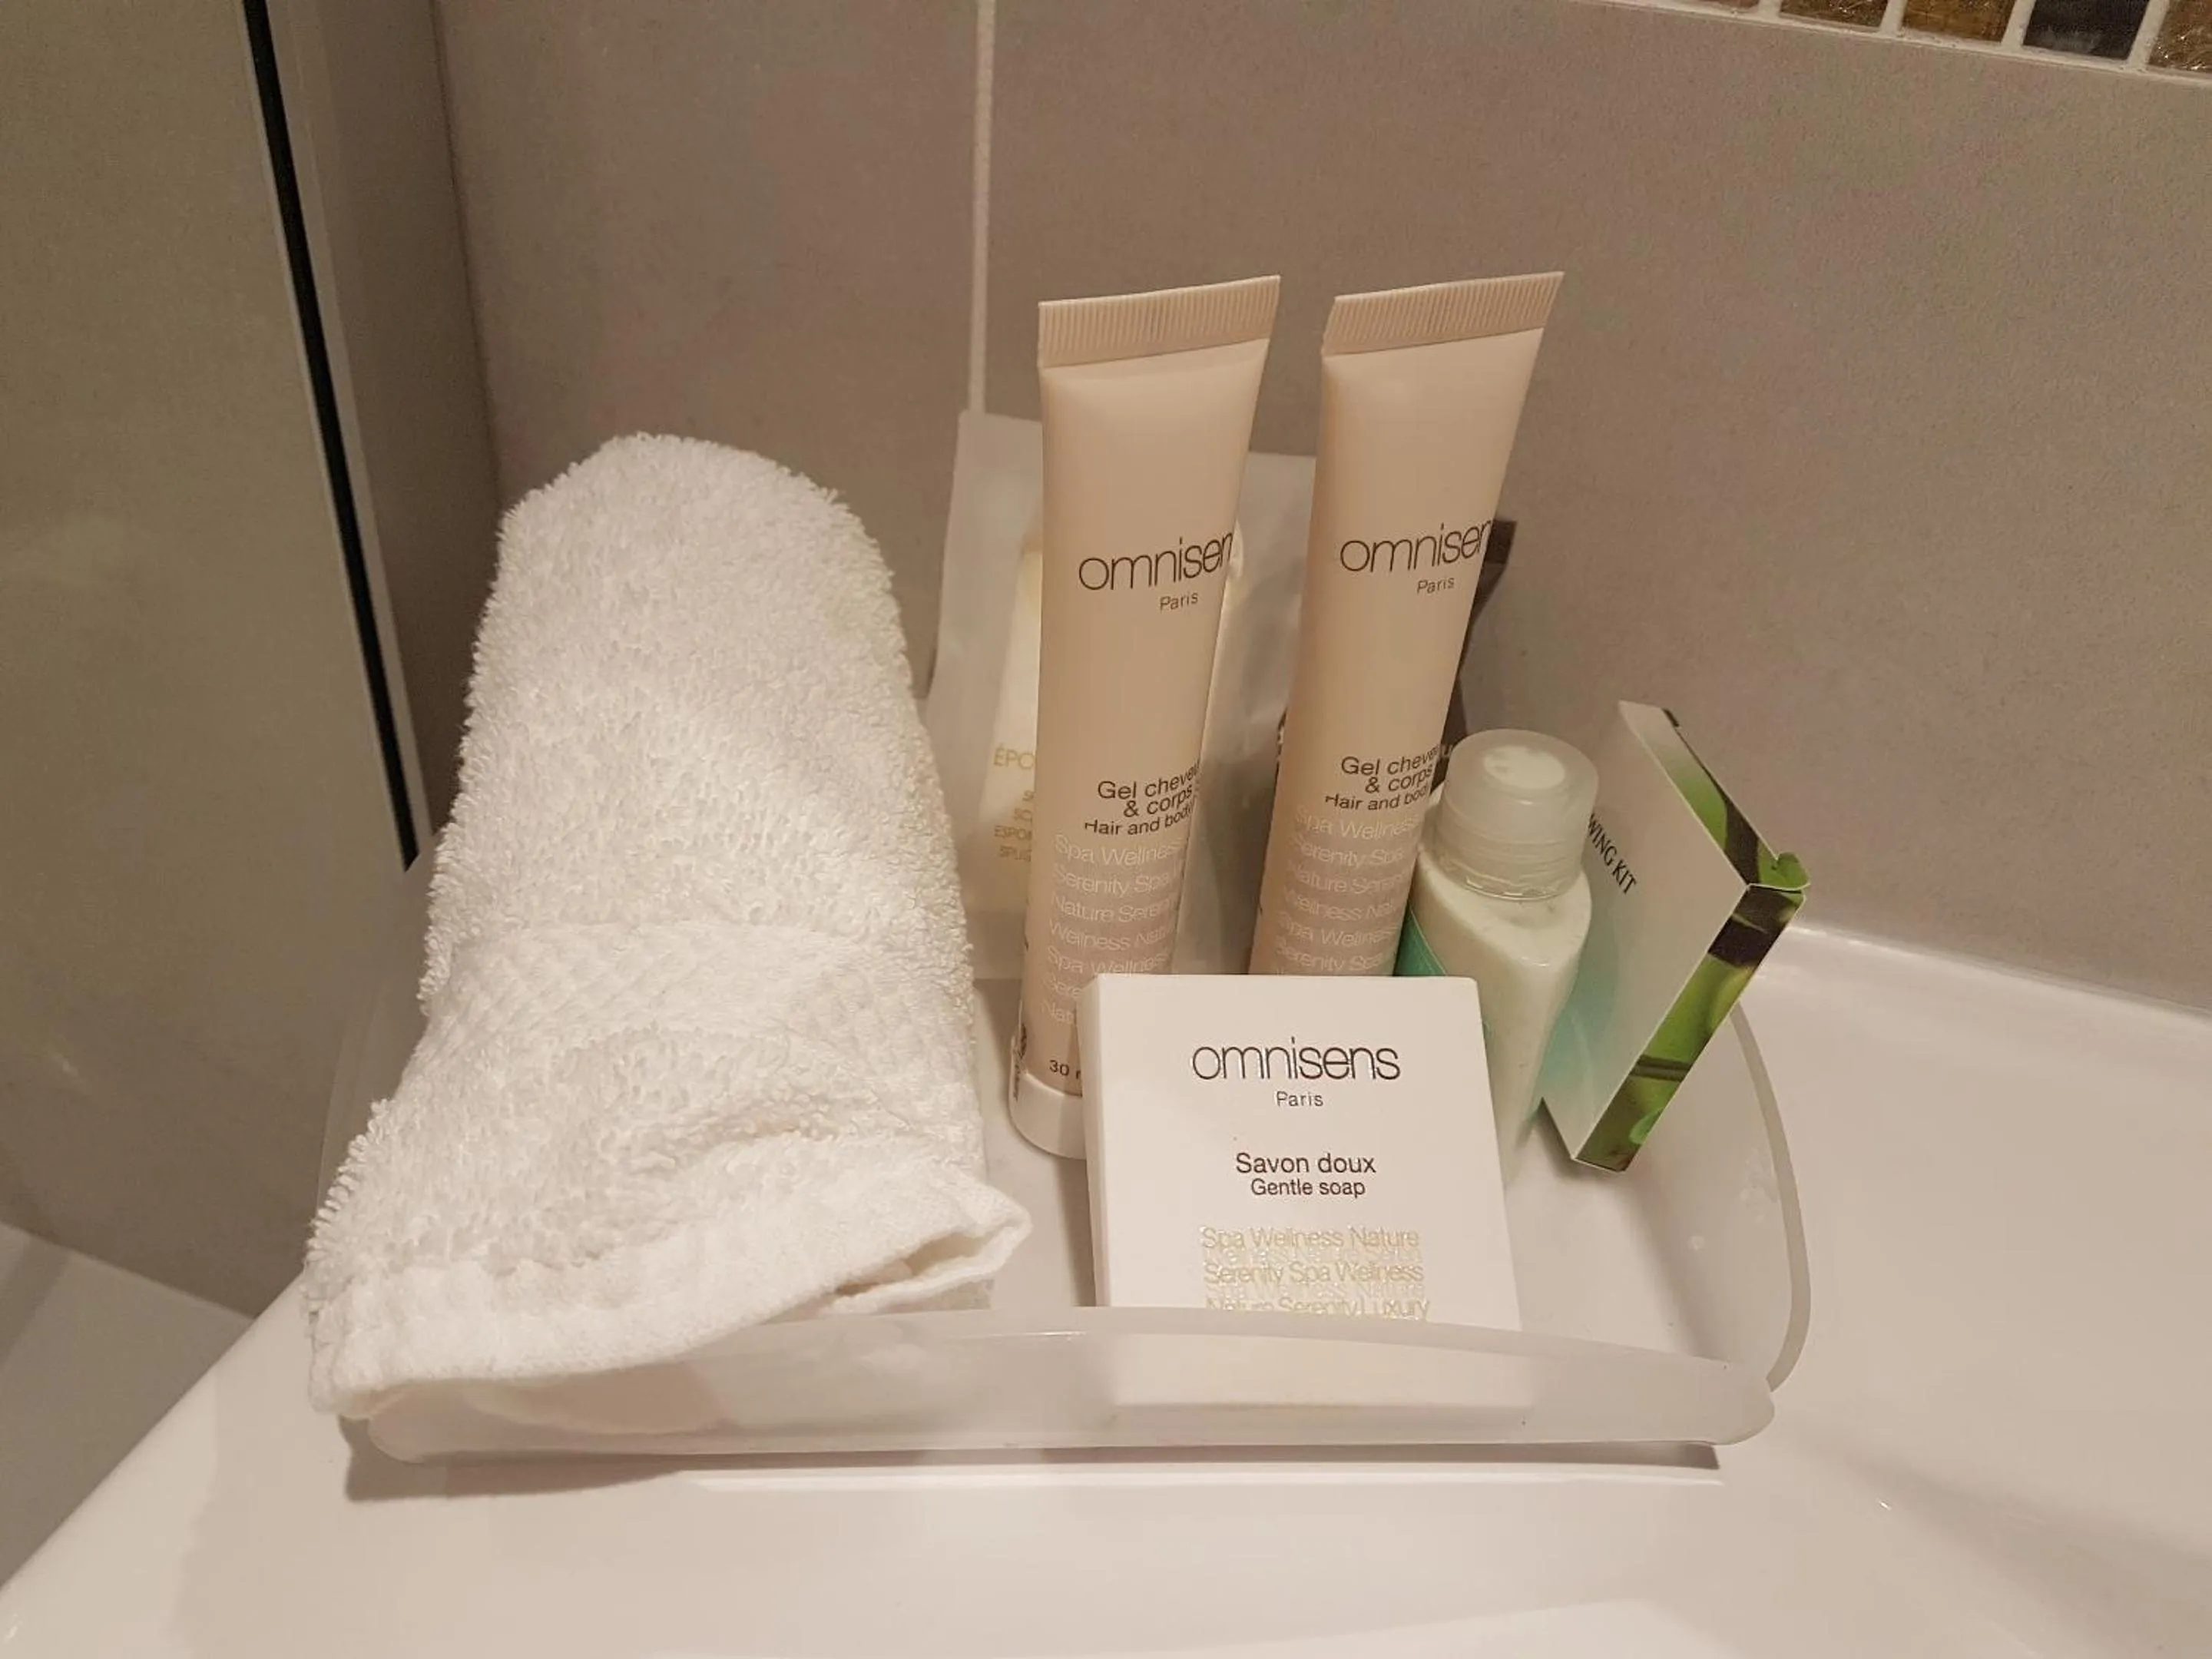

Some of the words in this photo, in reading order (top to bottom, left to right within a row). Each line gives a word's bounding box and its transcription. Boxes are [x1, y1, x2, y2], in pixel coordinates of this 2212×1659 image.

[1417, 577, 1455, 594] Paris
[1160, 592, 1198, 611] Paris
[1341, 756, 1380, 776] Gel
[1365, 776, 1380, 793] &
[1388, 763, 1433, 791] corps
[1098, 780, 1137, 800] Gel
[1123, 800, 1140, 818] &
[1147, 783, 1193, 815] corps
[1325, 793, 1363, 810] Hair
[1368, 794, 1400, 811] and
[1084, 819, 1123, 836] Hair
[1127, 816, 1161, 836] and
[1611, 858, 1637, 896] KIT
[1049, 1059, 1071, 1077] 30
[1192, 1036, 1401, 1080] omnisens
[1275, 1091, 1324, 1108] Paris
[1236, 1152, 1310, 1174] Savon
[1317, 1152, 1376, 1174] doux
[1251, 1177, 1313, 1196] Gentle
[1318, 1181, 1366, 1199] soap
[1200, 1226, 1245, 1251] Spa
[1249, 1226, 1345, 1247] Wellness
[1349, 1224, 1419, 1248] Nature
[1289, 1260, 1331, 1286] Spa
